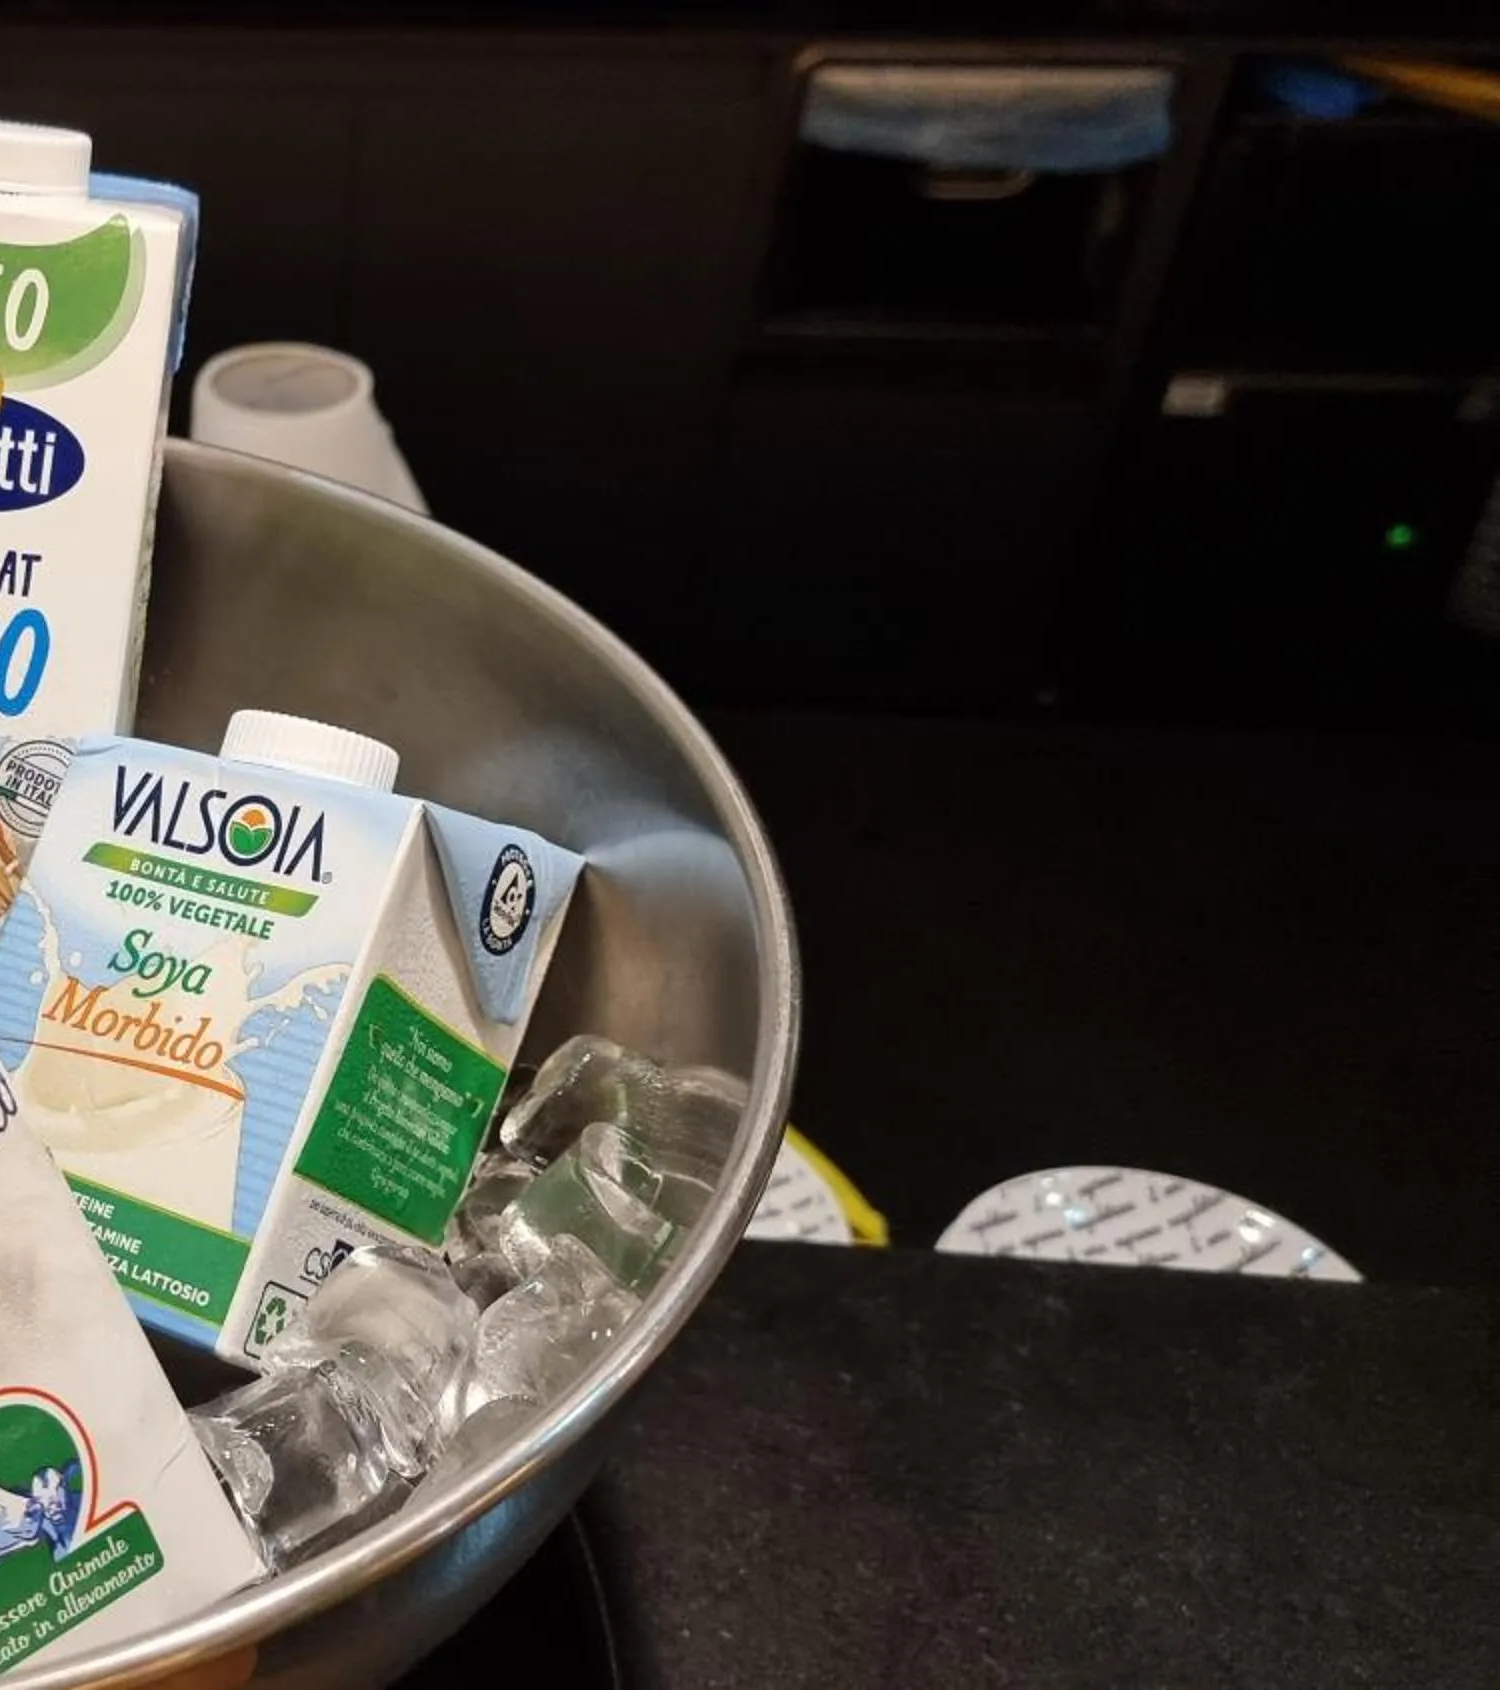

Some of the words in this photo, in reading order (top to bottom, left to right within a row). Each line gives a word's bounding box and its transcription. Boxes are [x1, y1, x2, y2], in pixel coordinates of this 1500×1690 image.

[5, 759, 60, 796] PRODOT
[5, 775, 23, 791] IN
[24, 783, 53, 808] ITAL
[113, 765, 326, 883] VALSOIA
[106, 879, 165, 911] 100%
[168, 896, 275, 941] VEGETALE
[191, 873, 204, 890] E
[206, 877, 272, 907] SALUTE
[107, 928, 213, 998] Soya
[41, 974, 223, 1071] Morbido
[72, 1190, 116, 1220] TEINE
[86, 1221, 143, 1255] TAMINE
[131, 1263, 211, 1307] LATTOSIO
[49, 1535, 130, 1598] Animale
[34, 1620, 55, 1639] in
[56, 1551, 157, 1624] allevamento
